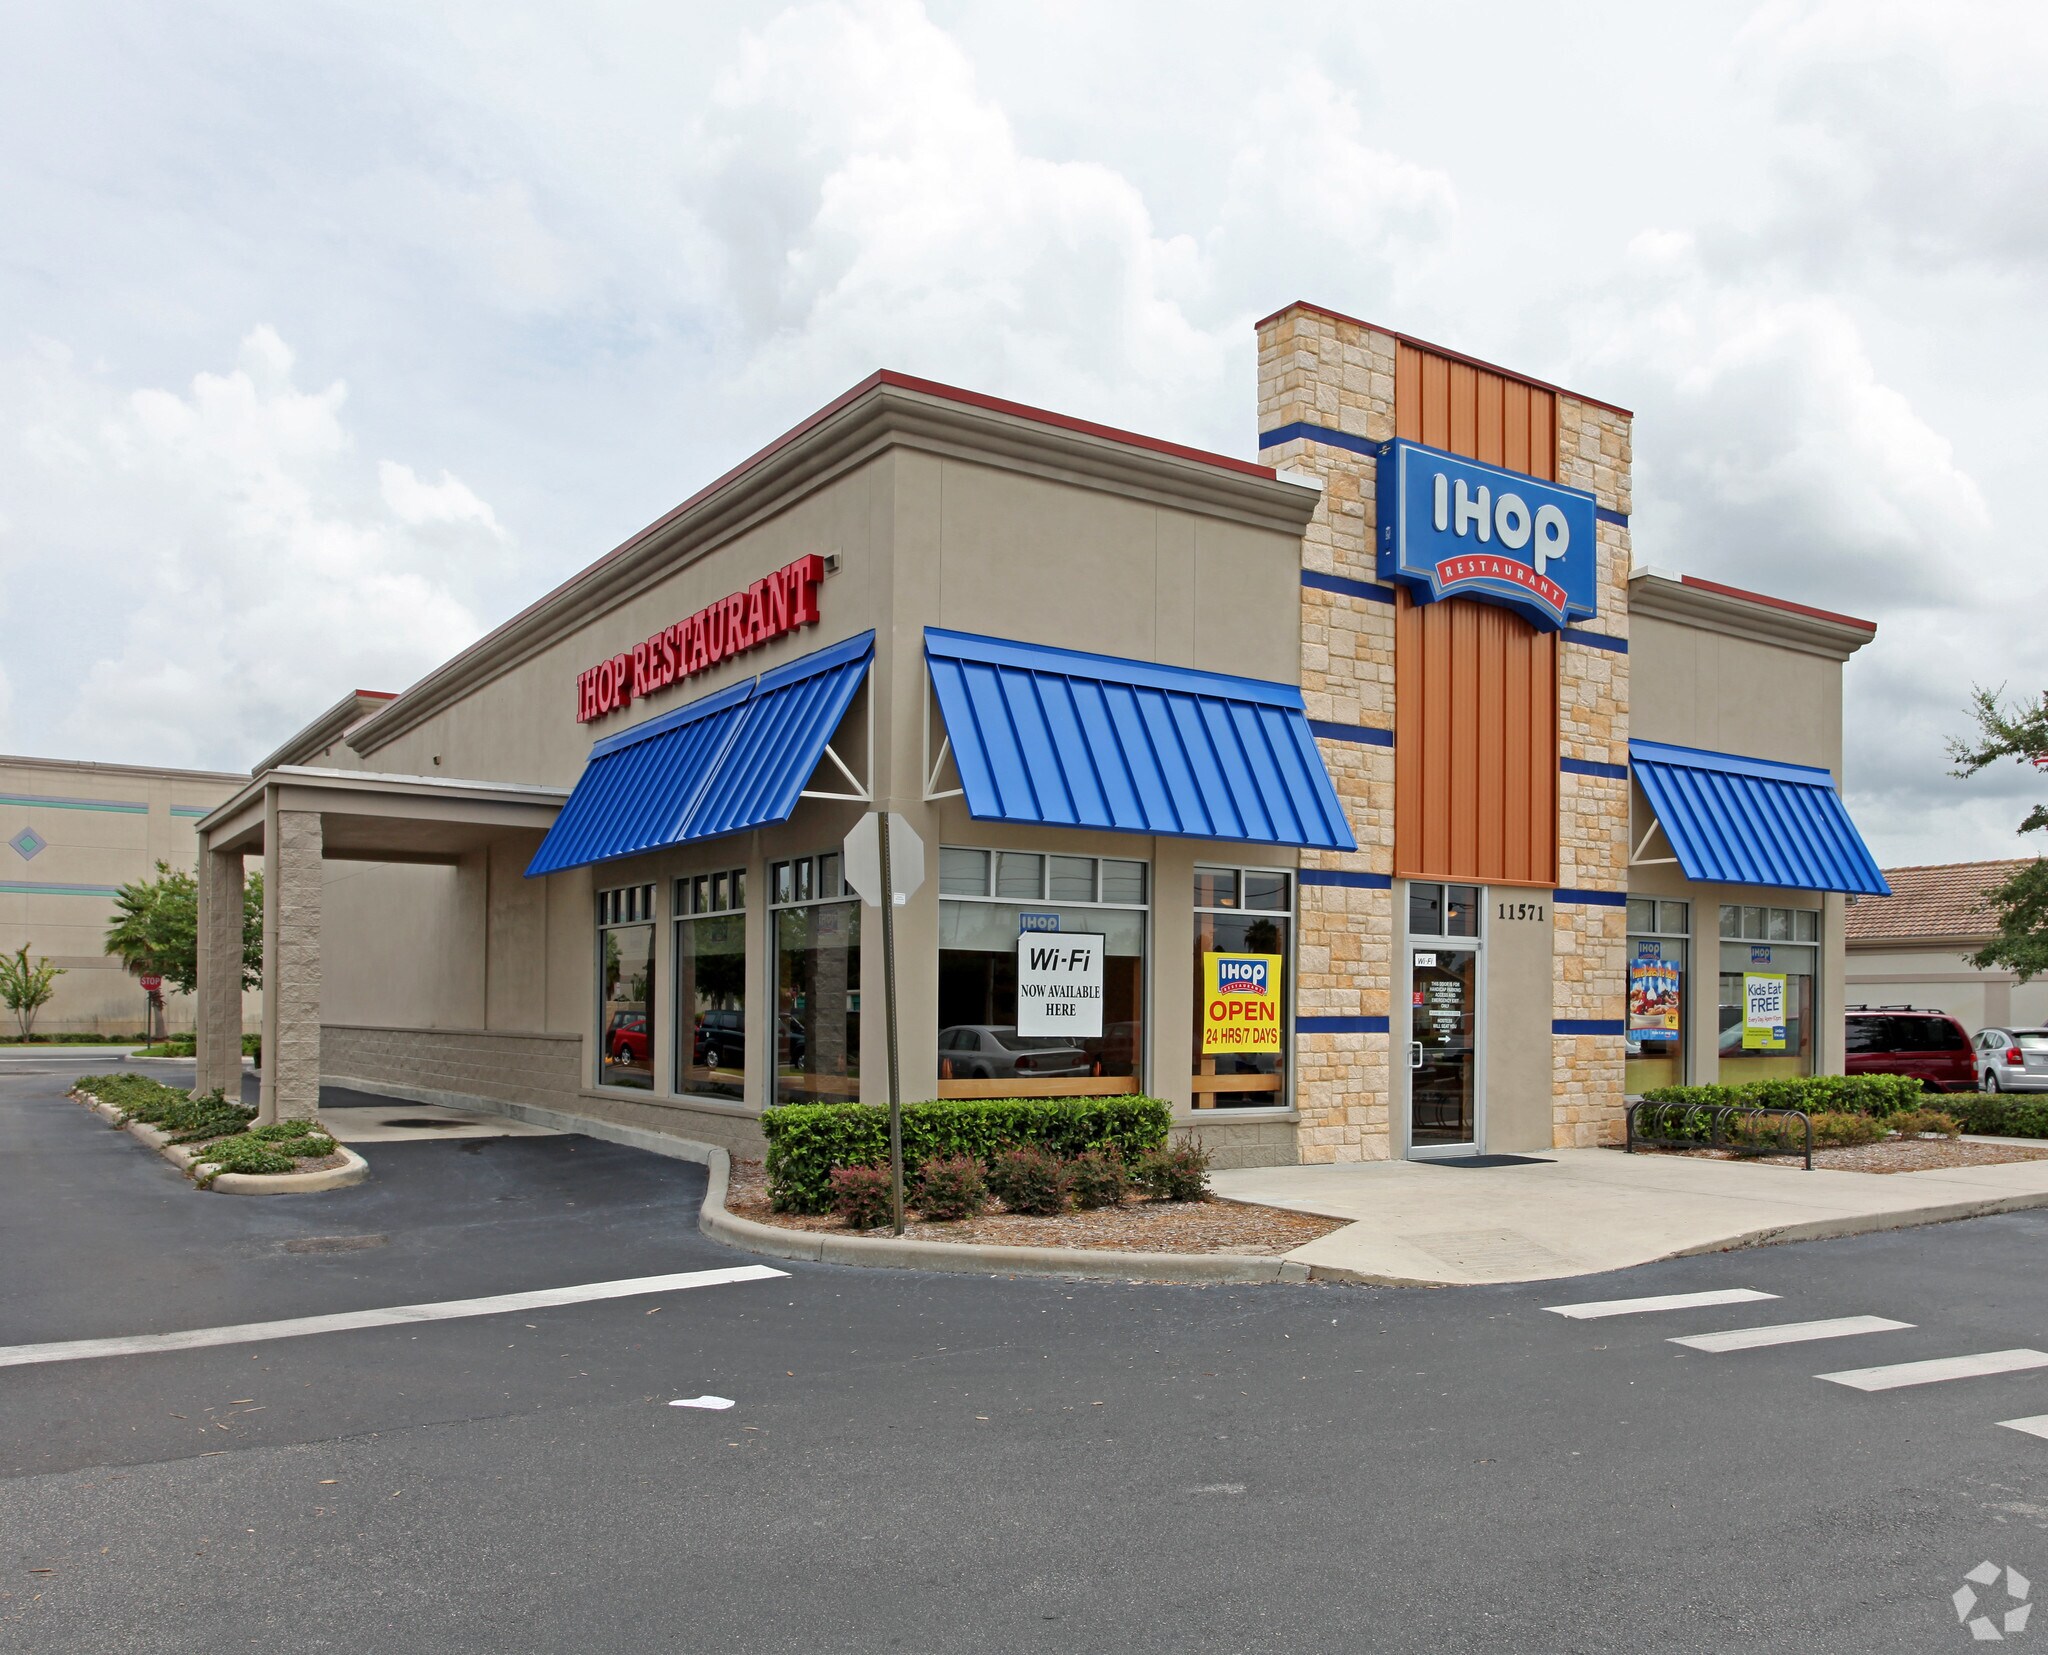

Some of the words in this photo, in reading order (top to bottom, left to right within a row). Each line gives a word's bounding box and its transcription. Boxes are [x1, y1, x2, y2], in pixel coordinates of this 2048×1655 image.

[1434, 473, 1570, 576] IHOP
[1445, 561, 1559, 600] RESTAURANT
[577, 653, 631, 723] IHOP
[632, 554, 824, 698] RESTAURANT
[1499, 903, 1544, 922] 11571
[1031, 948, 1091, 971] Wi-Fi
[141, 977, 160, 985] STOP
[1221, 964, 1265, 985] IHOP
[1021, 985, 1046, 998] NOW
[1048, 985, 1100, 998] AVAILABLE
[1748, 984, 1766, 997] Kids
[1767, 982, 1782, 995] Eat
[1046, 1003, 1077, 1016] HERE
[1209, 1001, 1275, 1021] OPEN
[1751, 996, 1779, 1013] FREE
[1206, 1028, 1218, 1044] 24
[1221, 1028, 1250, 1045] HRS/7
[1253, 1028, 1278, 1044] DAYS
